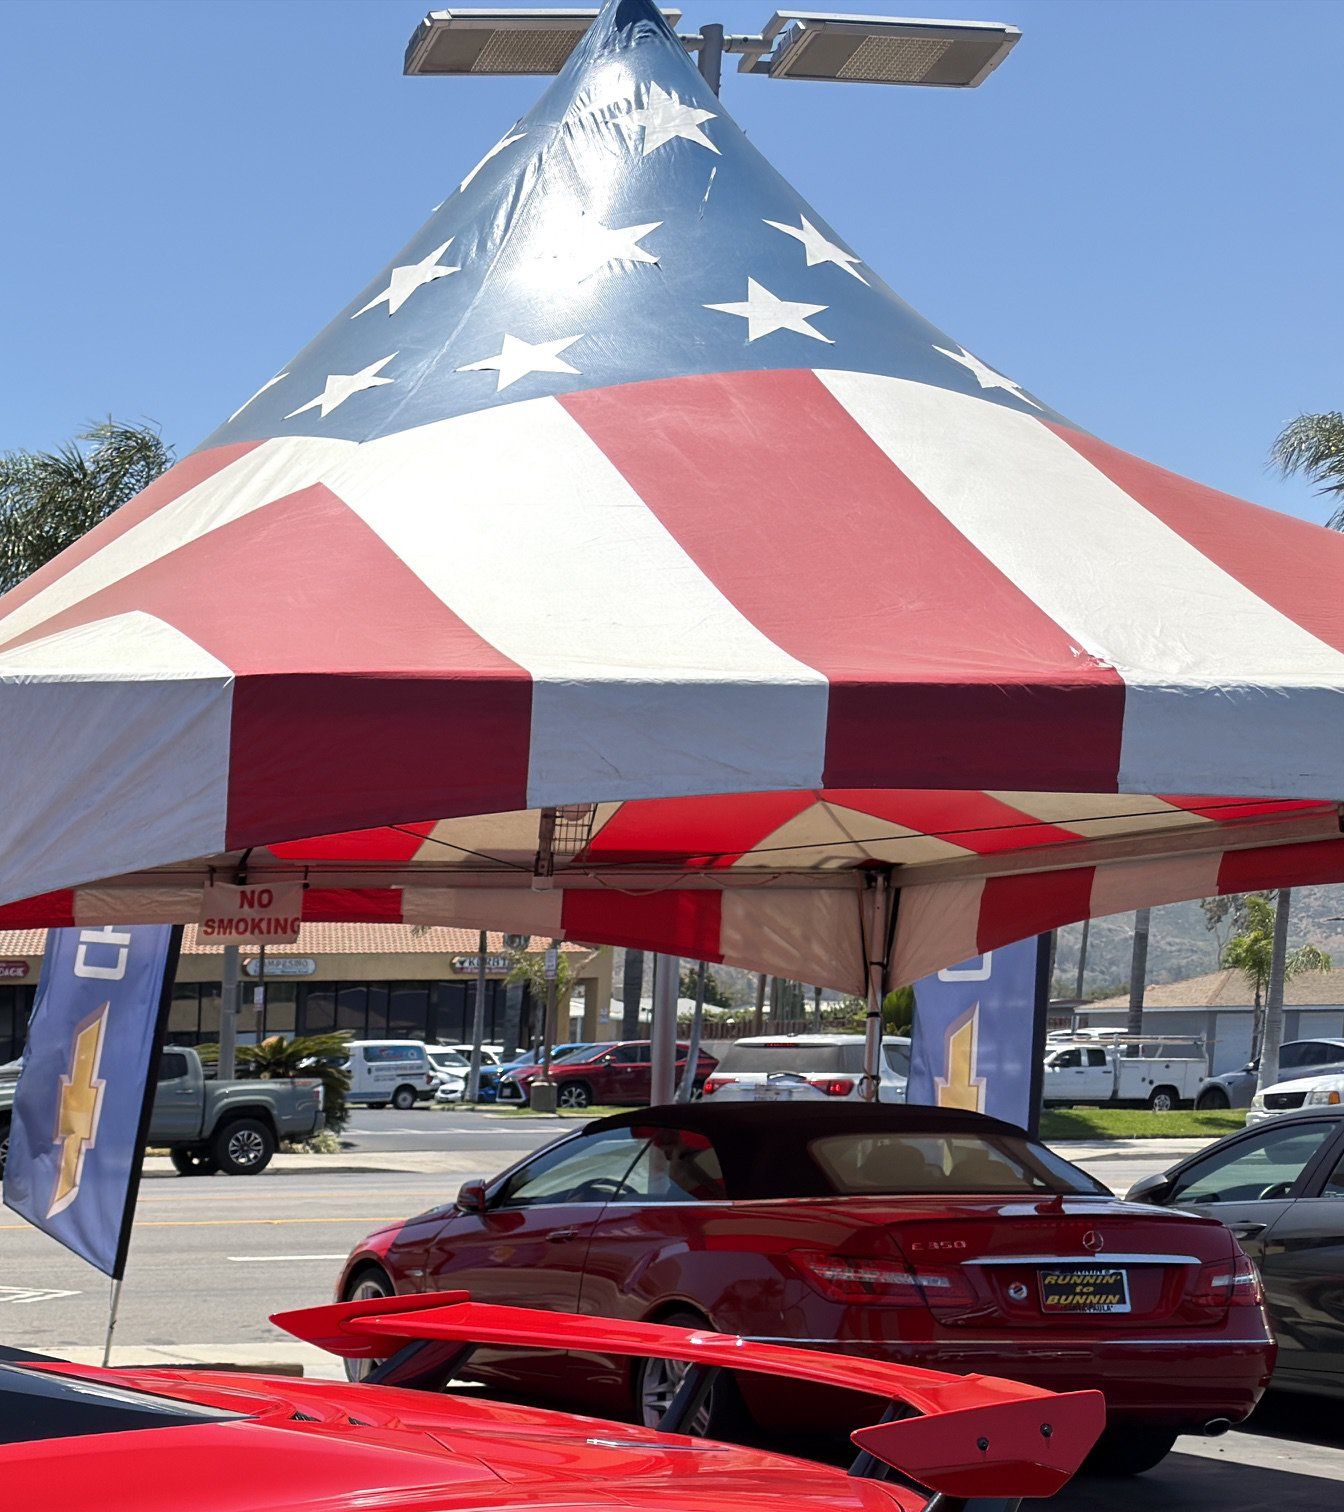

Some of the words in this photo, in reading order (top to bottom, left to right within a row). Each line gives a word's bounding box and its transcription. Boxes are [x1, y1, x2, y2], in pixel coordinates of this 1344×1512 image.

[239, 889, 273, 909] NO
[203, 917, 301, 935] SMOKING
[1075, 1285, 1094, 1293] to
[1046, 1295, 1120, 1304] BUNNIN
